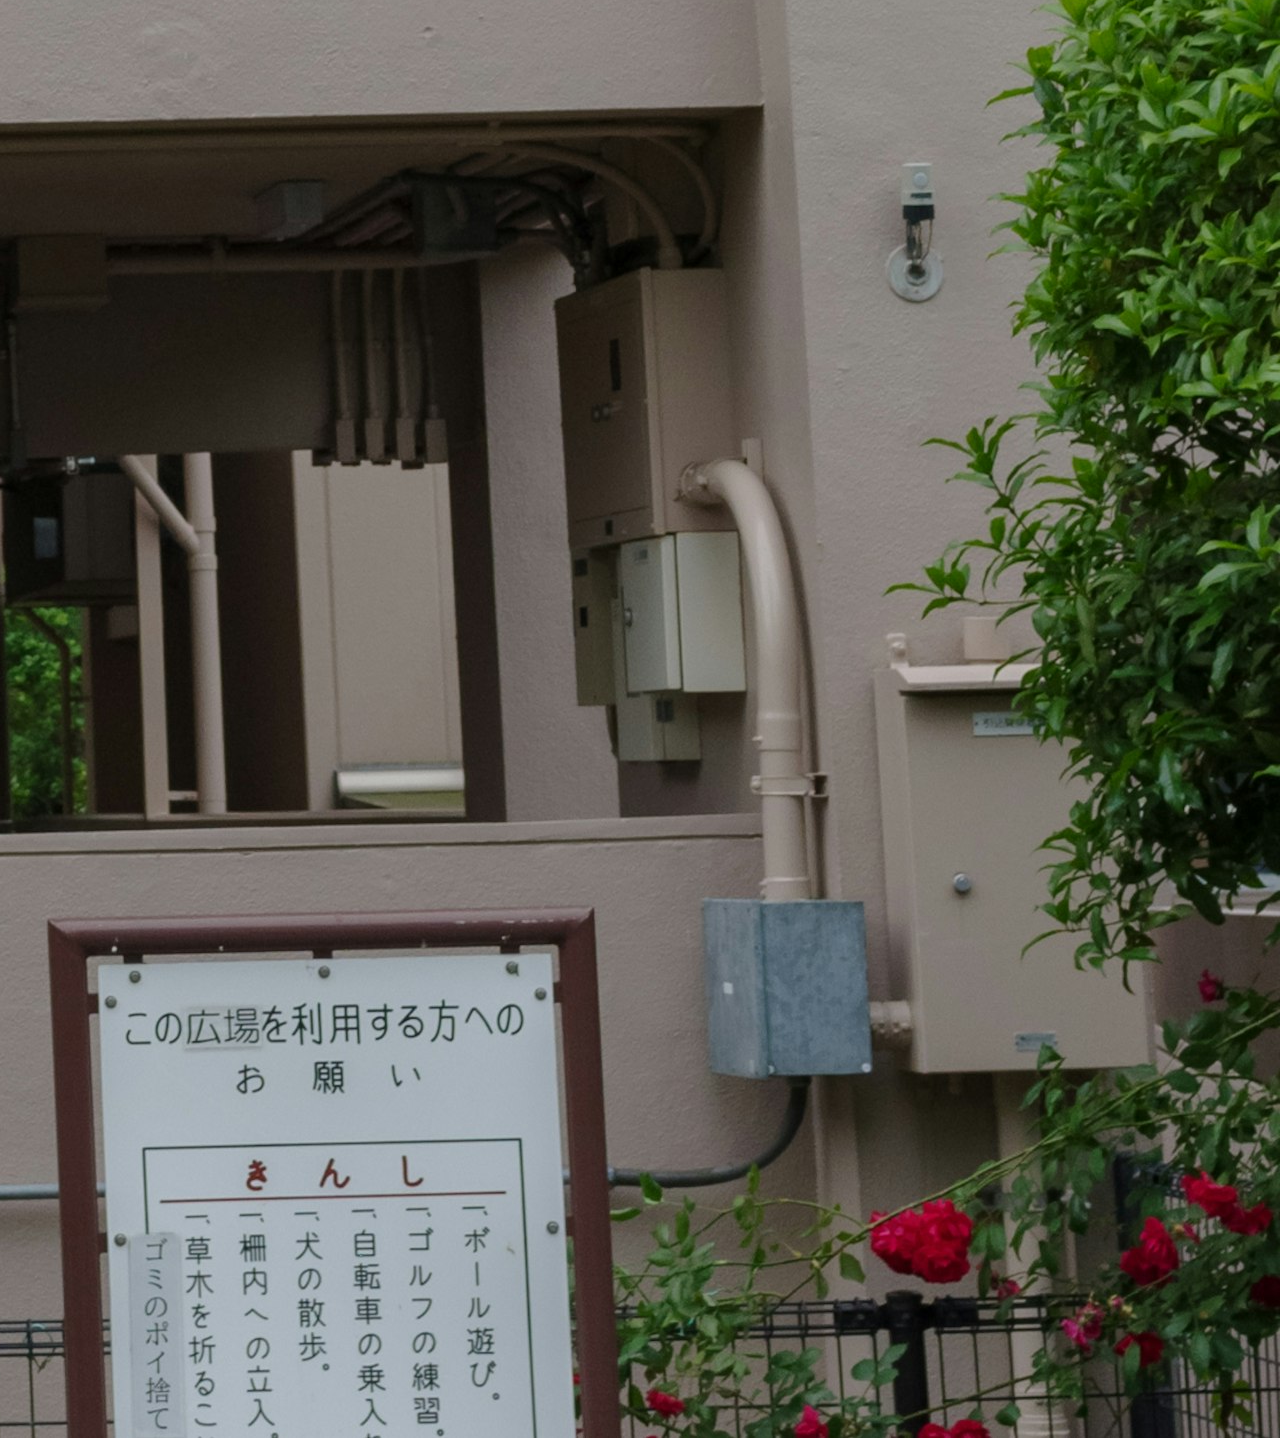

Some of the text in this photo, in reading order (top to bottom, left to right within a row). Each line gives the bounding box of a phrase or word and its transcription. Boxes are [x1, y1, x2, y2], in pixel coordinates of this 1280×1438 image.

[125, 999, 525, 1047] この広場を利用する方への
[184, 1214, 218, 1438] 一、草木を折るこ
[293, 1210, 331, 1372] 一、犬の散歩。
[350, 1208, 388, 1438] 一、自転車の乗入
[461, 1205, 501, 1401] 一、ボール遊び。
